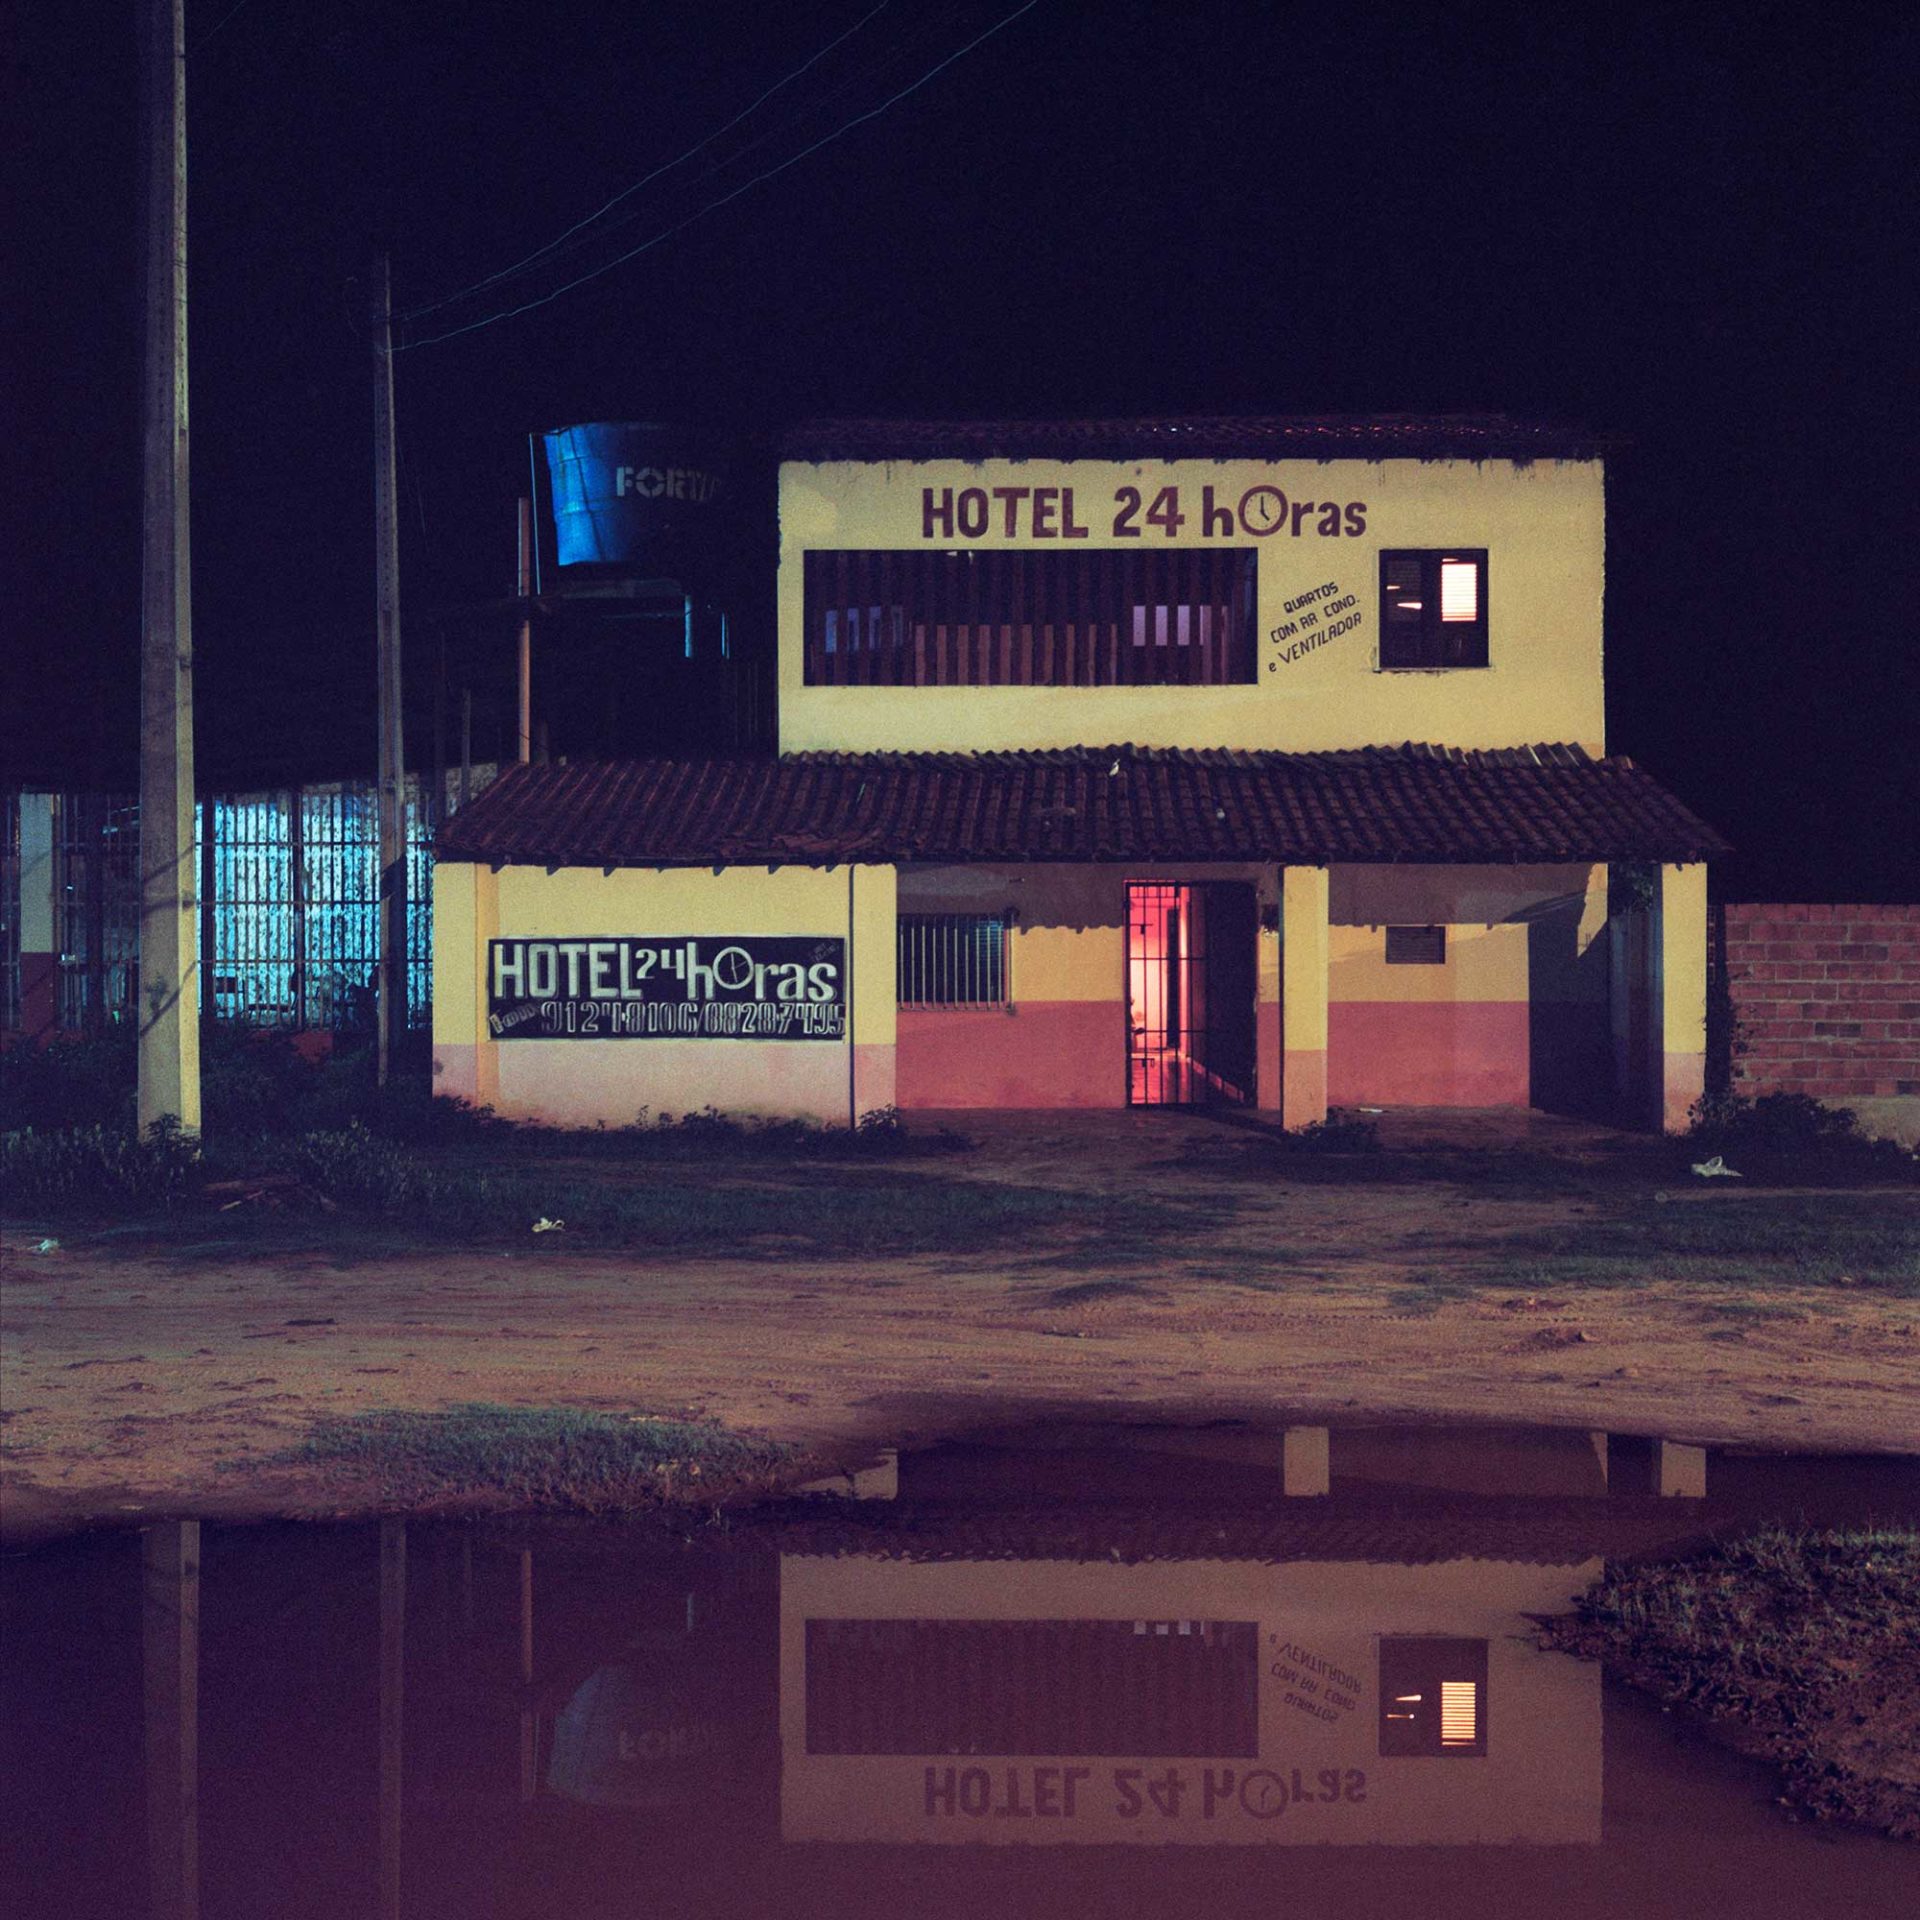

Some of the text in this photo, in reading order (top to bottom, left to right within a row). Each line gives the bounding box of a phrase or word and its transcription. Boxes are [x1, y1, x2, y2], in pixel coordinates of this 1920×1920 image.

[923, 487, 1088, 538] HOTEL
[1113, 486, 1185, 538] 24
[1270, 594, 1360, 643] COM AR COND.
[1283, 581, 1339, 613] QUARTOS
[1268, 612, 1362, 672] e VENTILADOR
[494, 943, 643, 1000] HOTEL
[636, 949, 684, 980] 24
